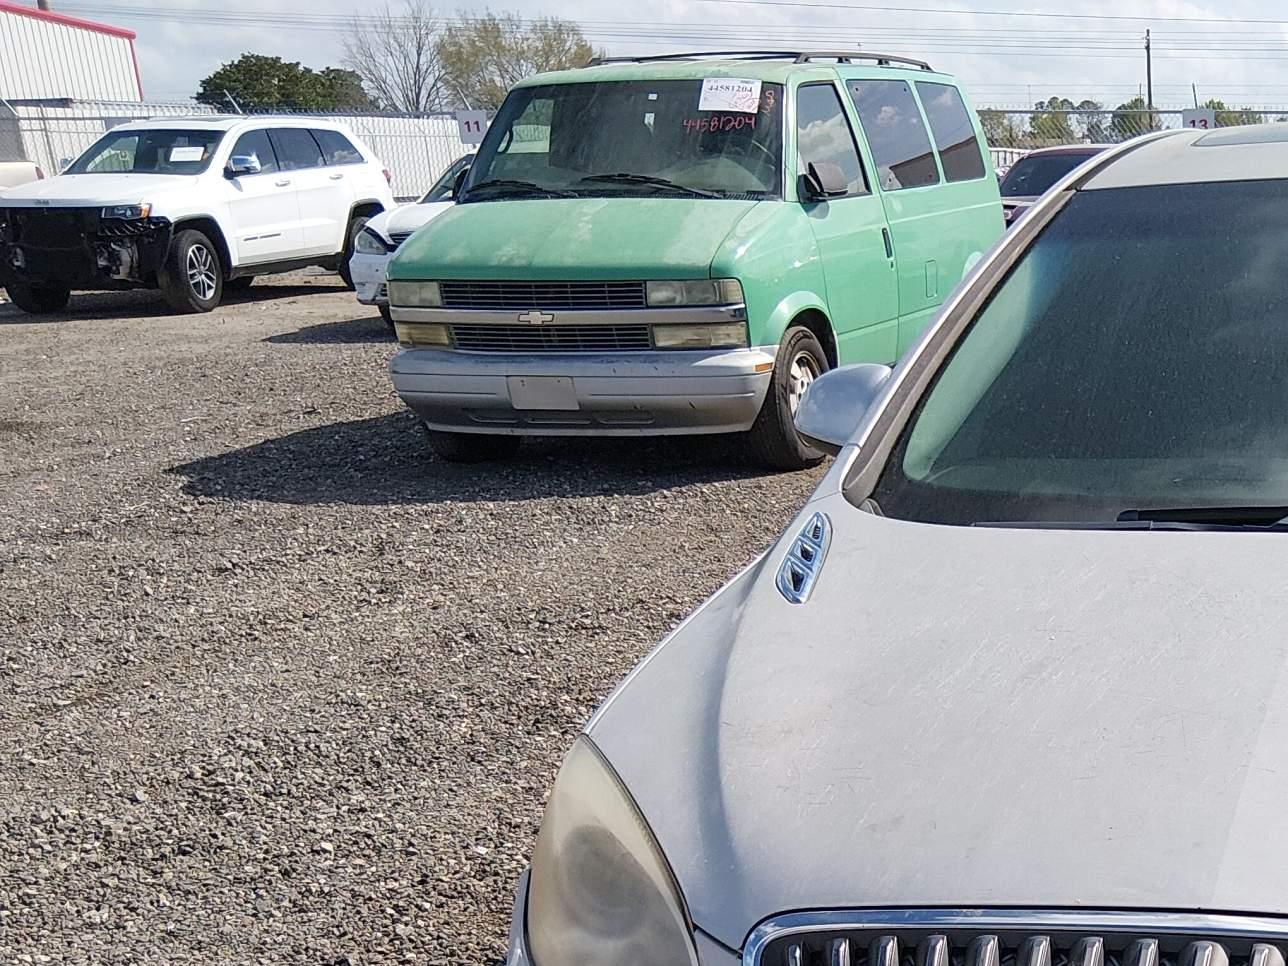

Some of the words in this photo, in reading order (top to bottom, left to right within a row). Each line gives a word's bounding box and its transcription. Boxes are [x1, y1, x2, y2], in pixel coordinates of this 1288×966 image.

[709, 85, 753, 93] 44581204
[464, 120, 481, 132] 11
[682, 116, 756, 134] 44581204
[1189, 118, 1208, 129] 13
